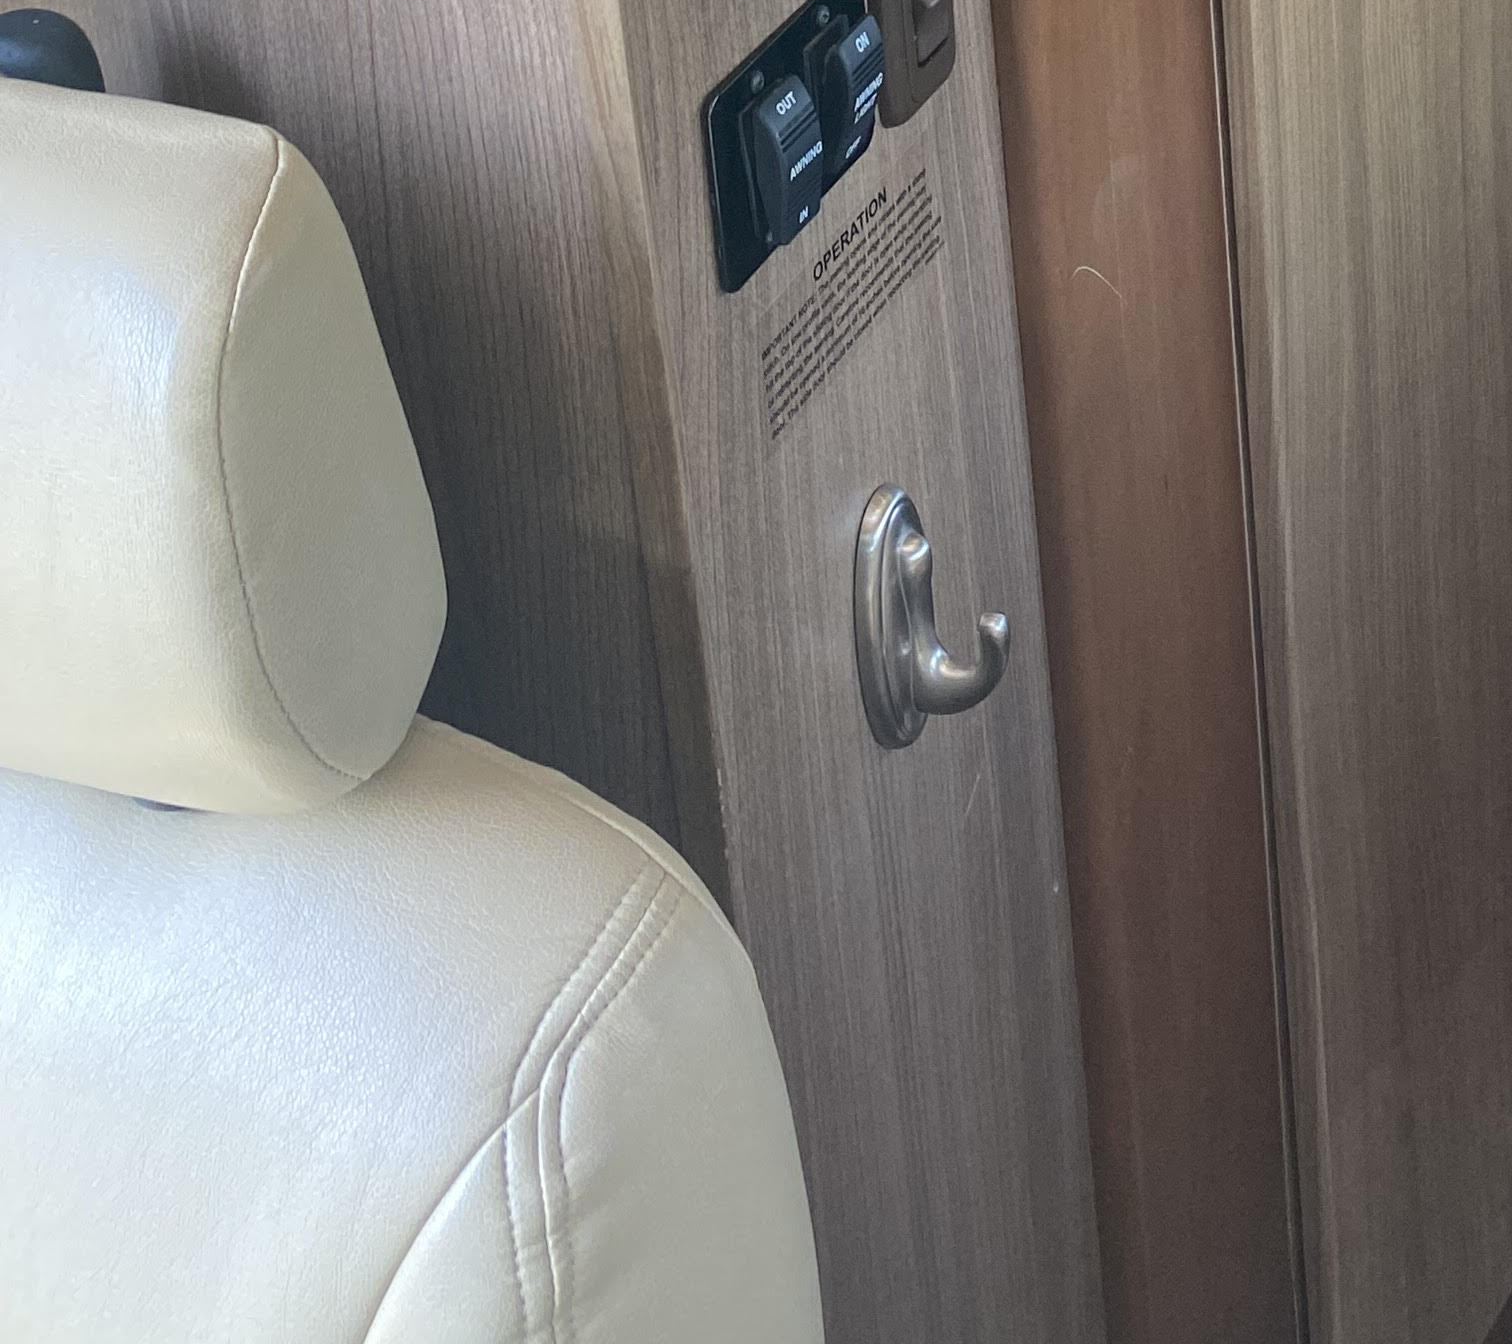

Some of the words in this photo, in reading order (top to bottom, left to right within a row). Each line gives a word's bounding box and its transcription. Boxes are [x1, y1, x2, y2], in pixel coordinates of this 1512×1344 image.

[855, 31, 870, 53] ON
[776, 90, 798, 115] OUT
[854, 72, 883, 112] AWNING
[790, 140, 823, 182] AWNING
[799, 206, 809, 224] IN
[813, 185, 888, 282] OPERATION
